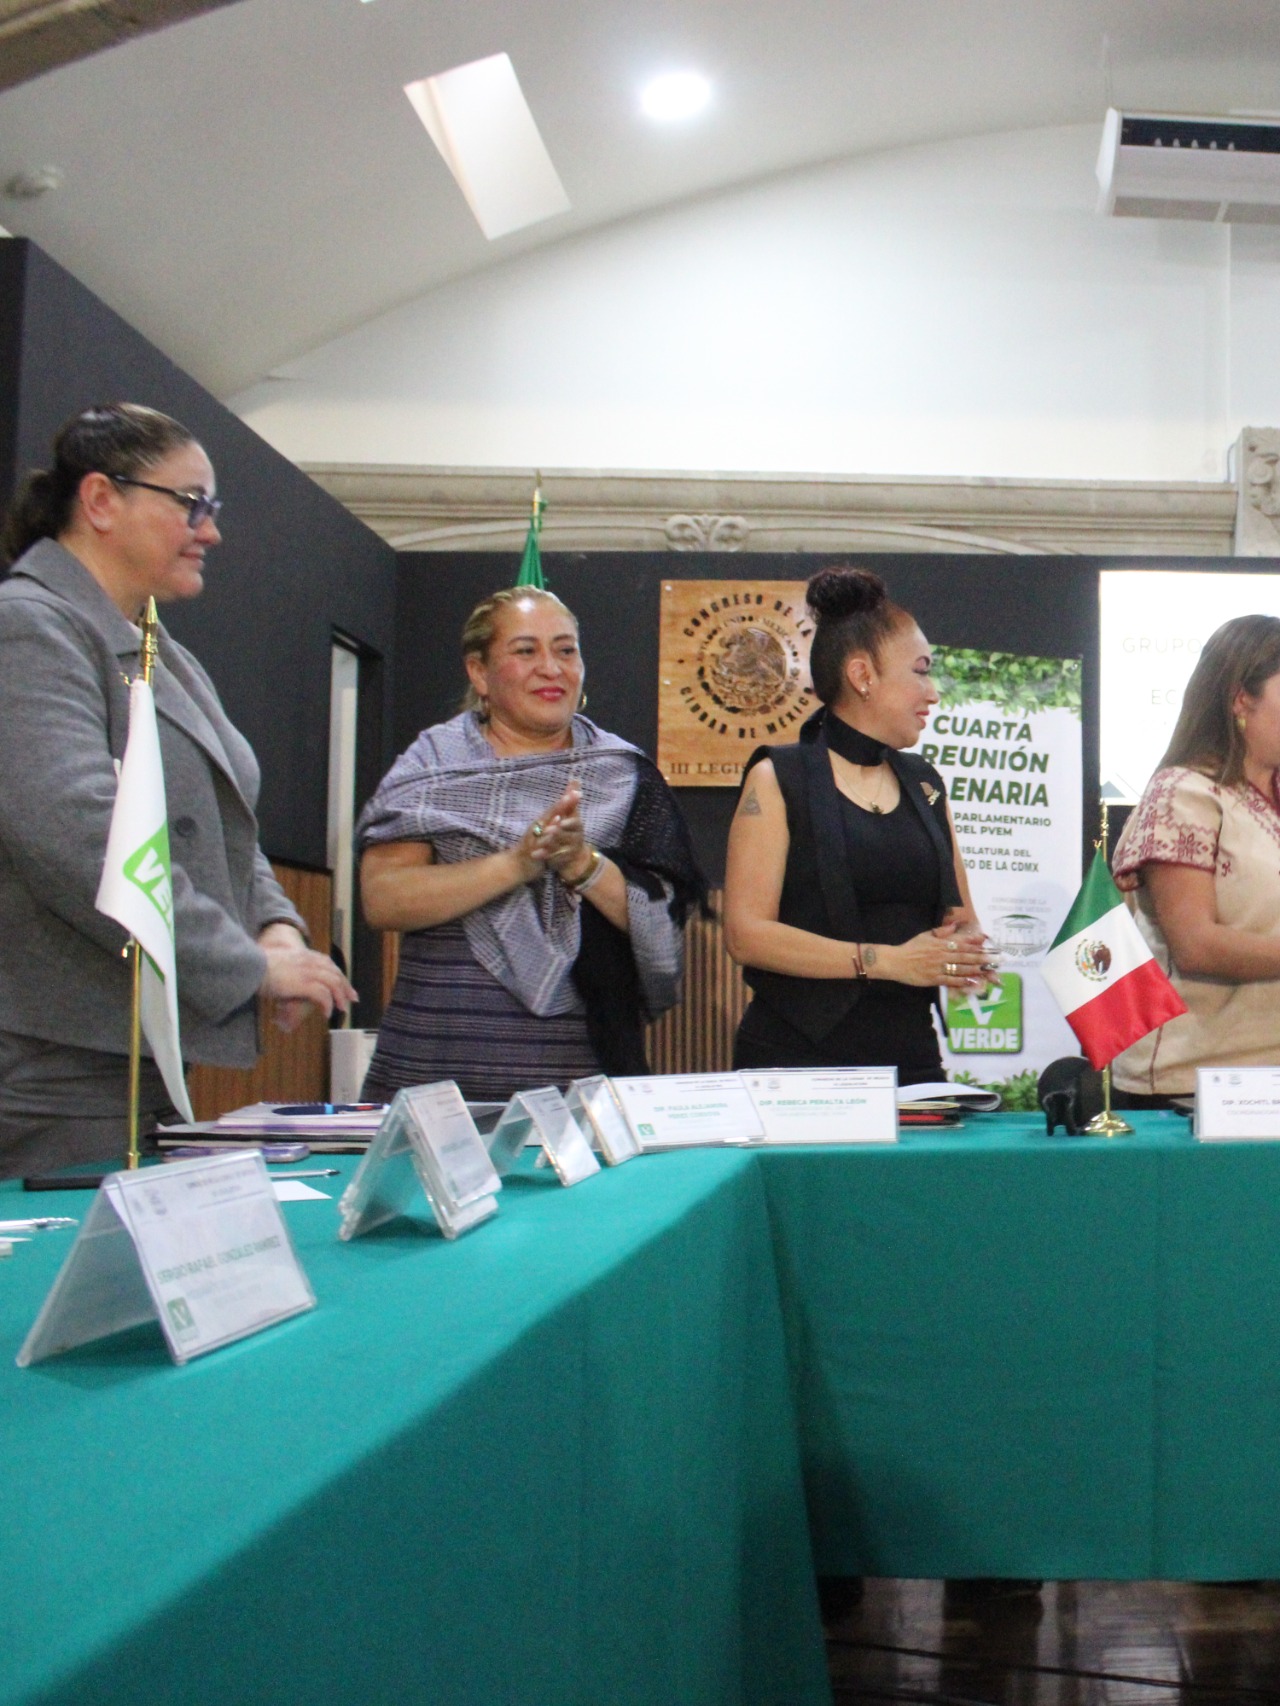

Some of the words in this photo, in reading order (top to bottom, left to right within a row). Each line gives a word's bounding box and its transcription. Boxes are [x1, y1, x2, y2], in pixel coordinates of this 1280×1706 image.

[683, 593, 763, 637] CONGRESO
[933, 715, 1032, 742] CUARTA
[697, 762, 743, 775] LEGI
[921, 744, 1049, 773] REUNIÓN
[947, 777, 1049, 807] ENARIA
[954, 812, 1051, 827] PARLAMENTARIO
[955, 825, 976, 834] DEL
[980, 826, 1012, 836] PVEM
[960, 846, 1010, 856] ISLATURA
[950, 1028, 1019, 1050] VERDE
